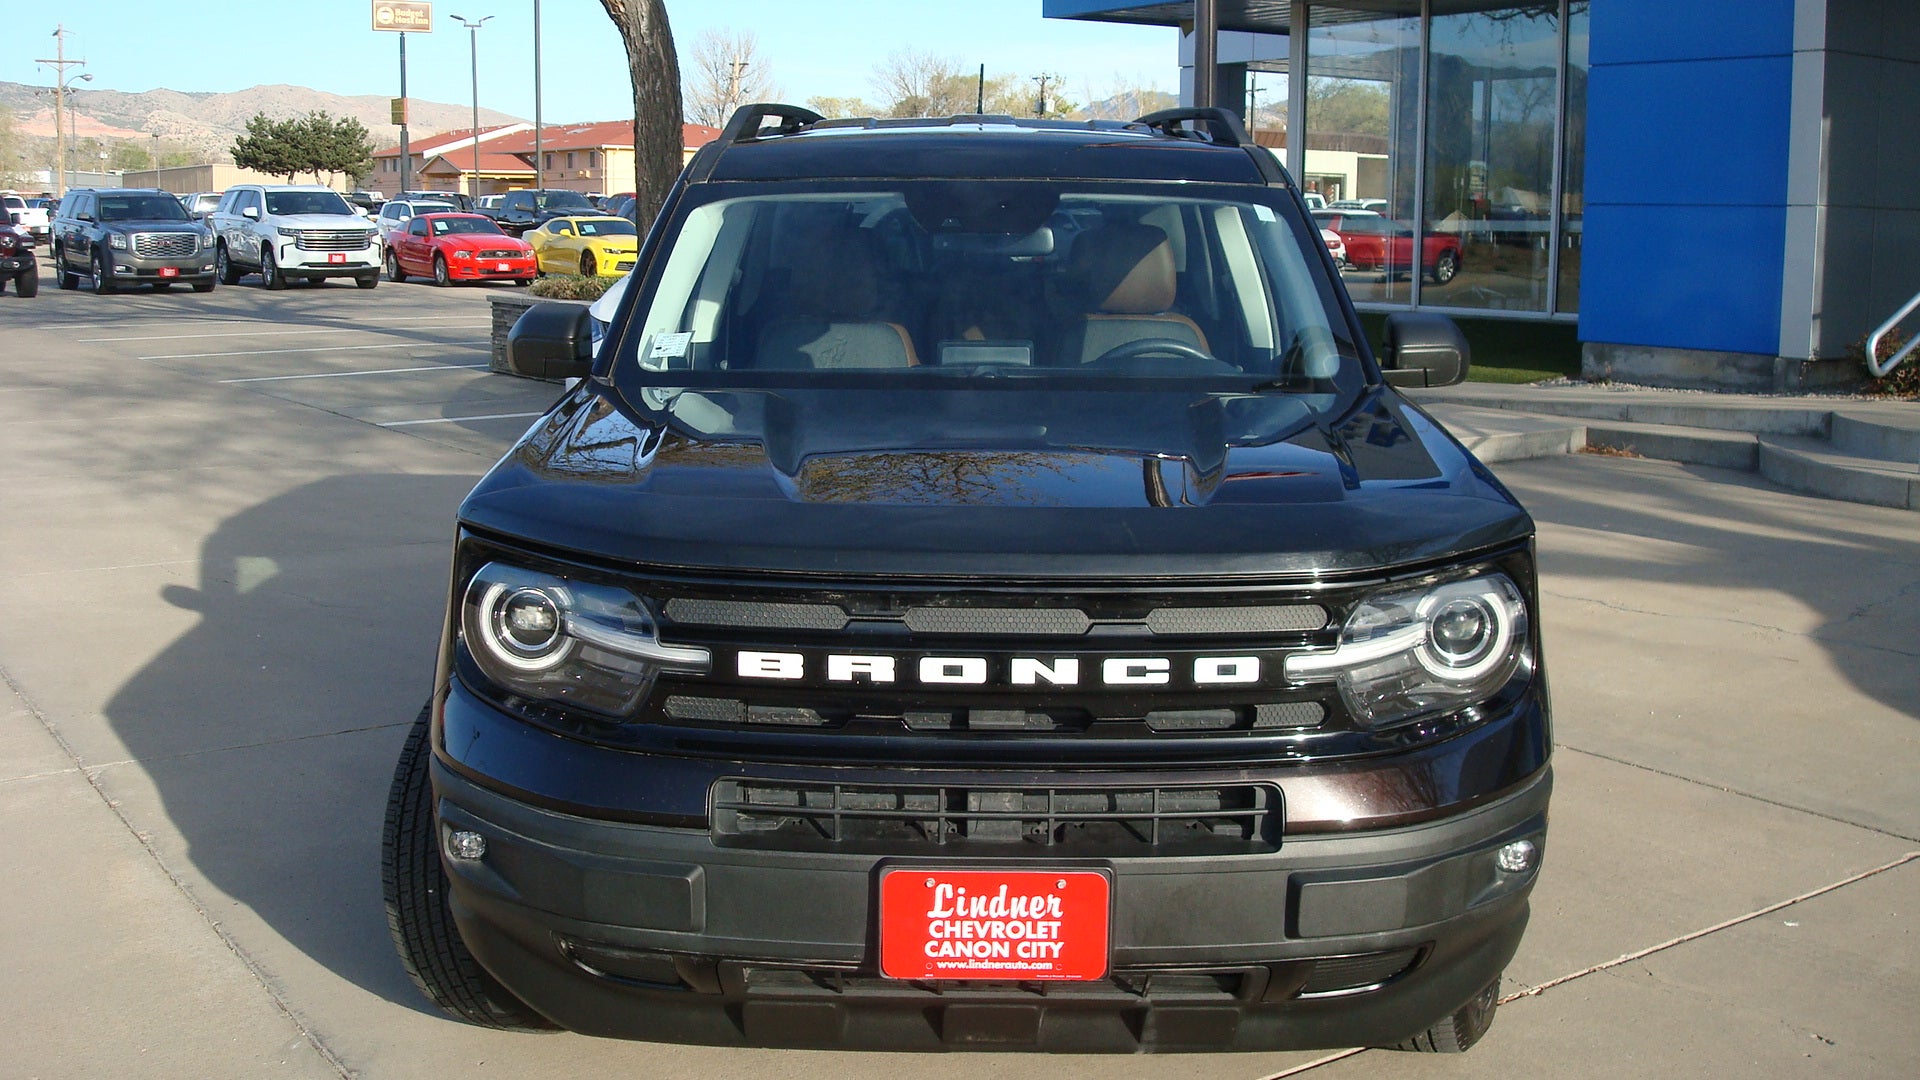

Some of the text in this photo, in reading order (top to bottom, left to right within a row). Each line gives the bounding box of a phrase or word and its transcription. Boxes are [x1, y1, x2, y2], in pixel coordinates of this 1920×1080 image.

[394, 8, 424, 20] Budget
[415, 16, 429, 25] Inn
[737, 650, 1261, 685] BRONCO
[927, 883, 1064, 919] Lindner
[928, 920, 1062, 939] CHEVROLET
[924, 941, 1065, 959] CANON CITY
[937, 959, 1053, 970] www.lindnerauto.com
